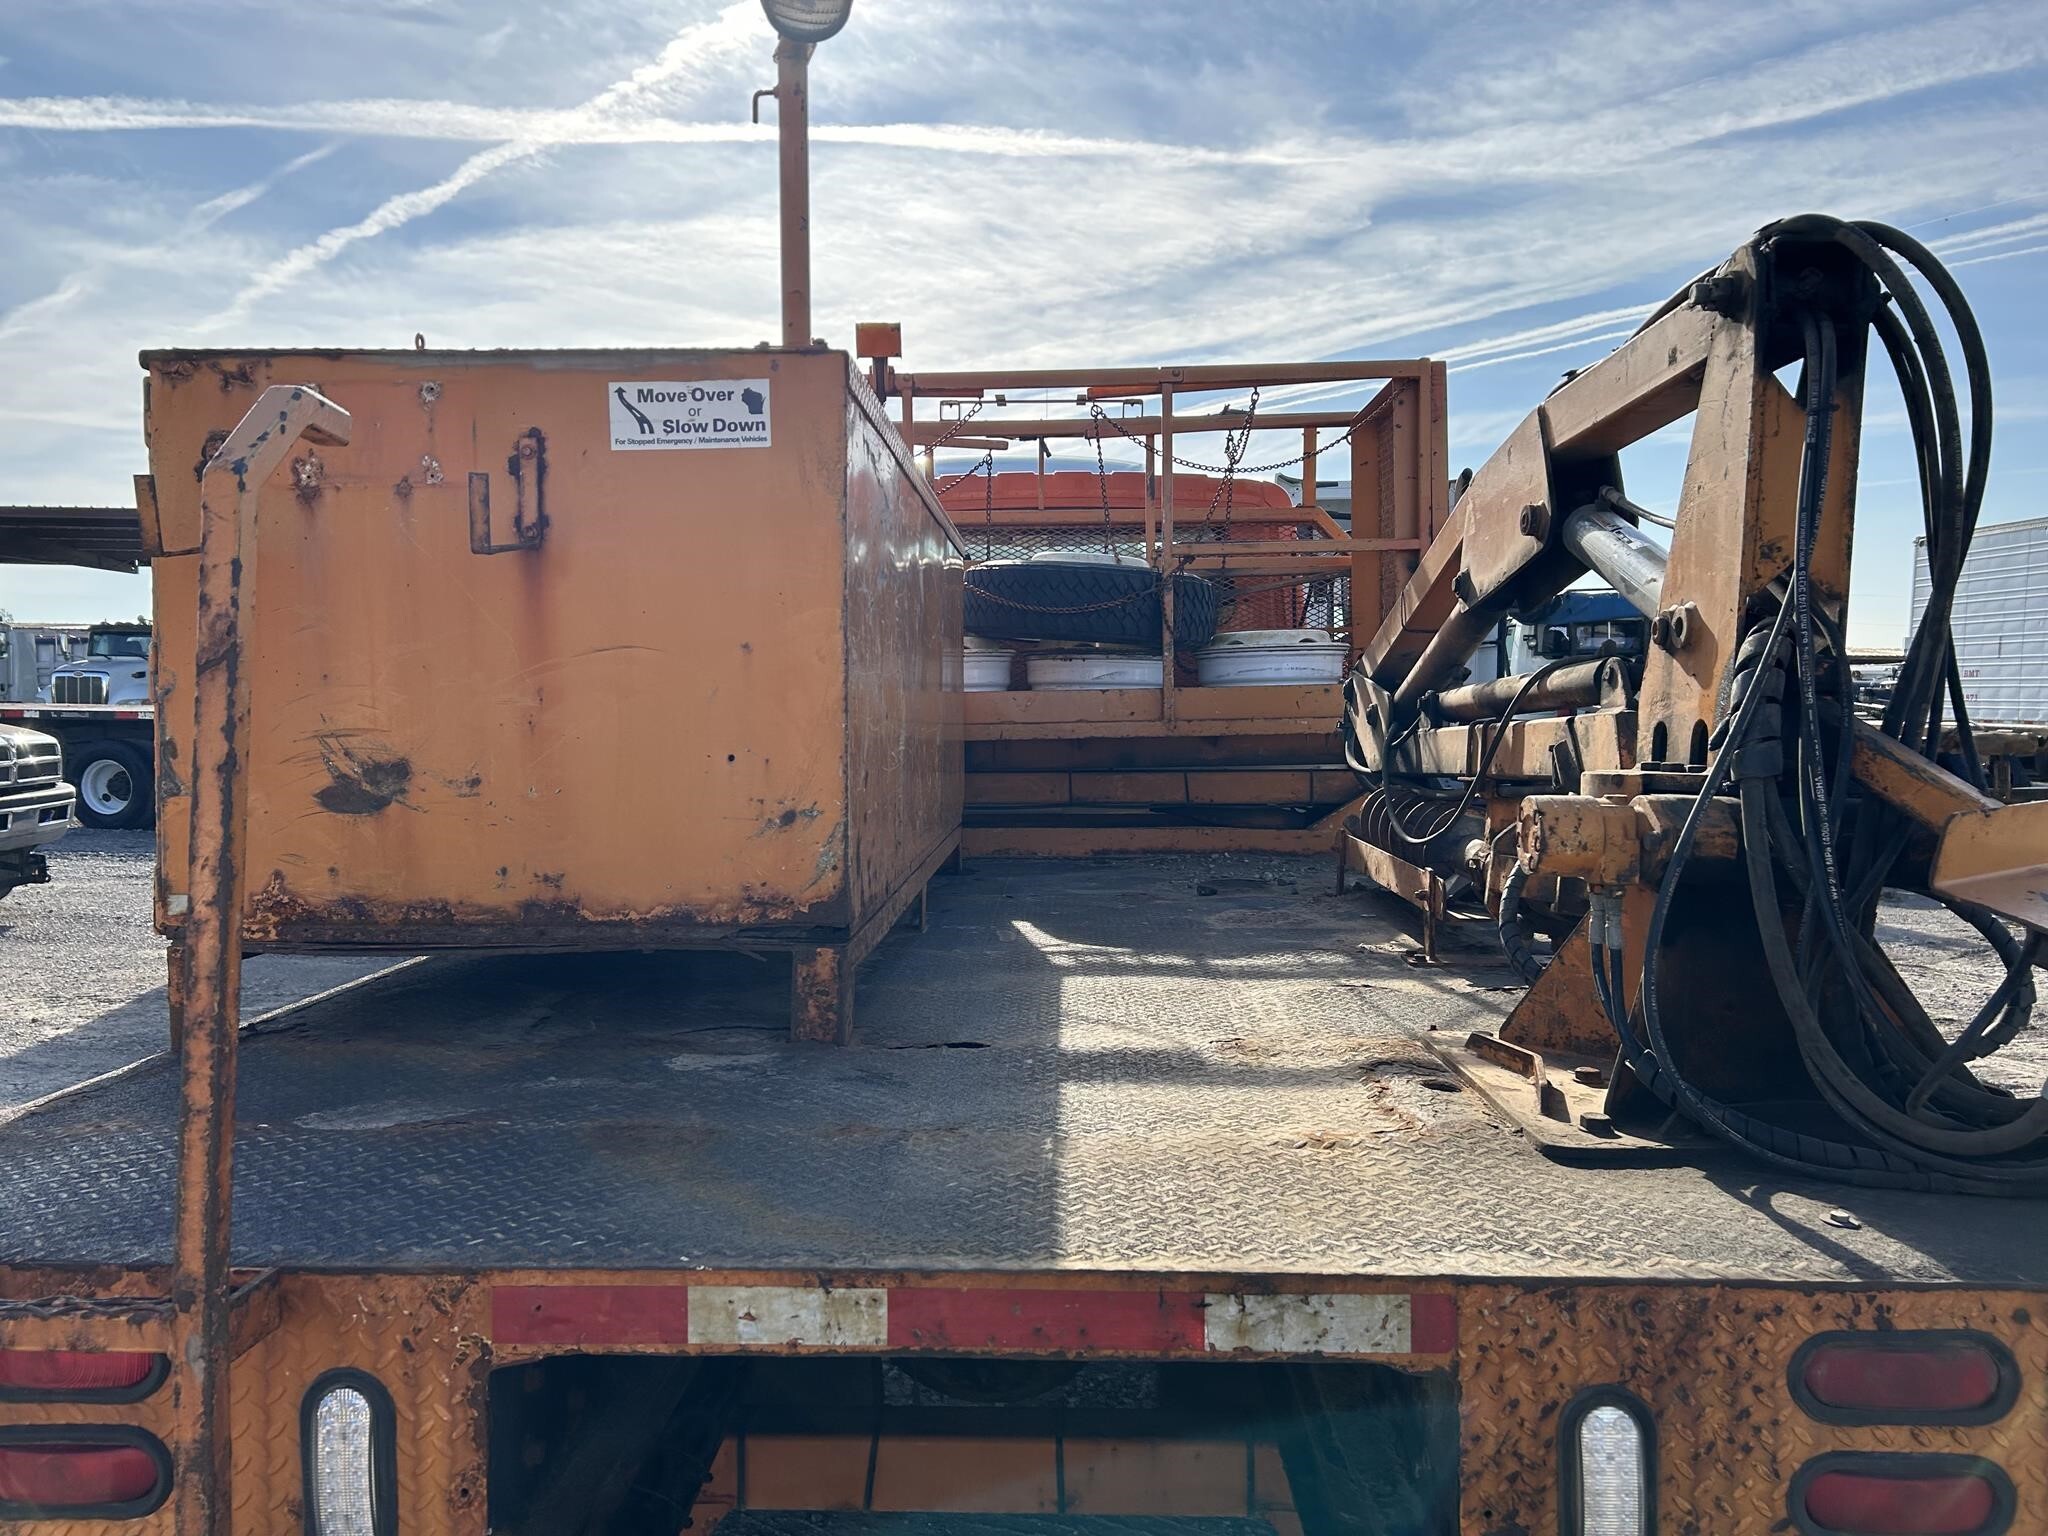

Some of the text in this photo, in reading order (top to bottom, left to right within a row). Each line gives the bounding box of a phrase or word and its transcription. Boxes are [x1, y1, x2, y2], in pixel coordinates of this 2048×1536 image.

[637, 387, 735, 403] Move Over
[688, 407, 702, 417] or
[662, 418, 766, 434] Slow Down
[627, 437, 655, 447] Stopped
[656, 437, 693, 446] Emergency
[698, 436, 740, 444] Maintenance
[742, 435, 768, 443] Vehicles
